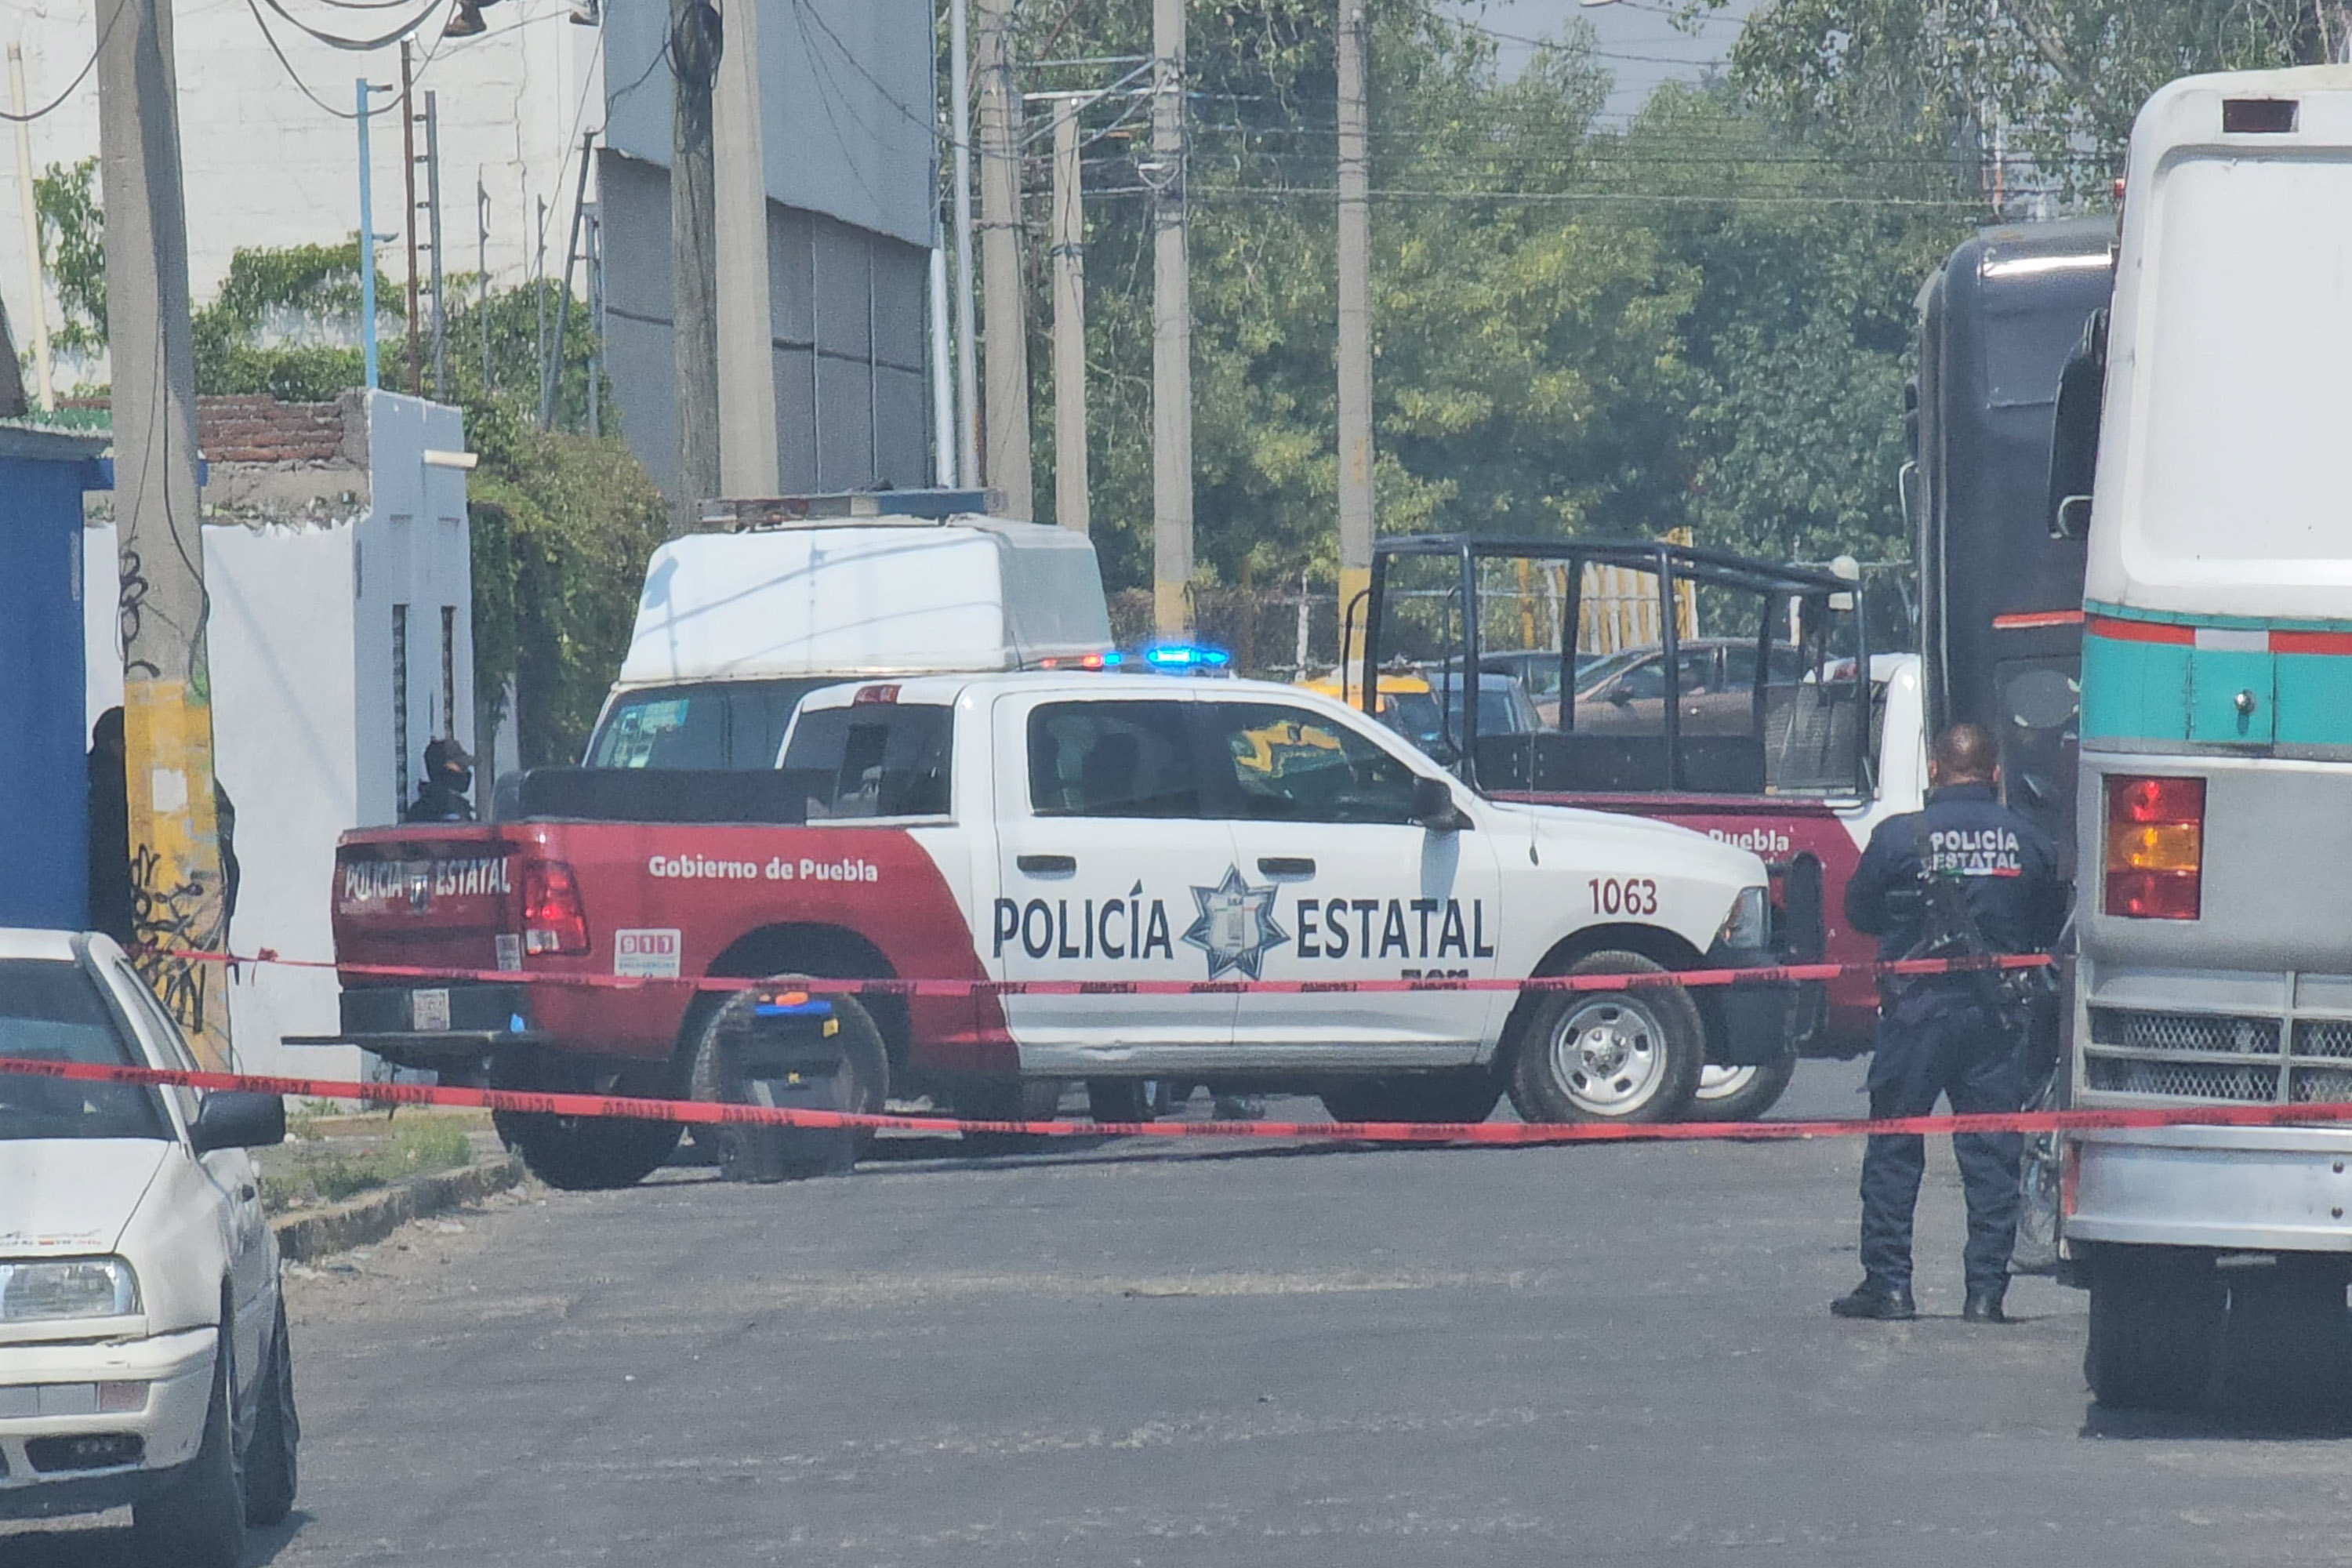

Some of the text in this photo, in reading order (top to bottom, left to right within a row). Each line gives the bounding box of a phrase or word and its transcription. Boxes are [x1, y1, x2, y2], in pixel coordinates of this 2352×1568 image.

[1709, 828, 1789, 852] Puebla
[1929, 826, 2020, 851] POLICÍA
[648, 854, 878, 882] Gobierno de Puebla
[1933, 851, 2022, 870] ESTATAL
[435, 857, 511, 895] ESTATAL
[1588, 877, 1657, 915] 1063
[993, 878, 1494, 959] POLICÍA ESTATAL
[622, 936, 672, 953] 911
